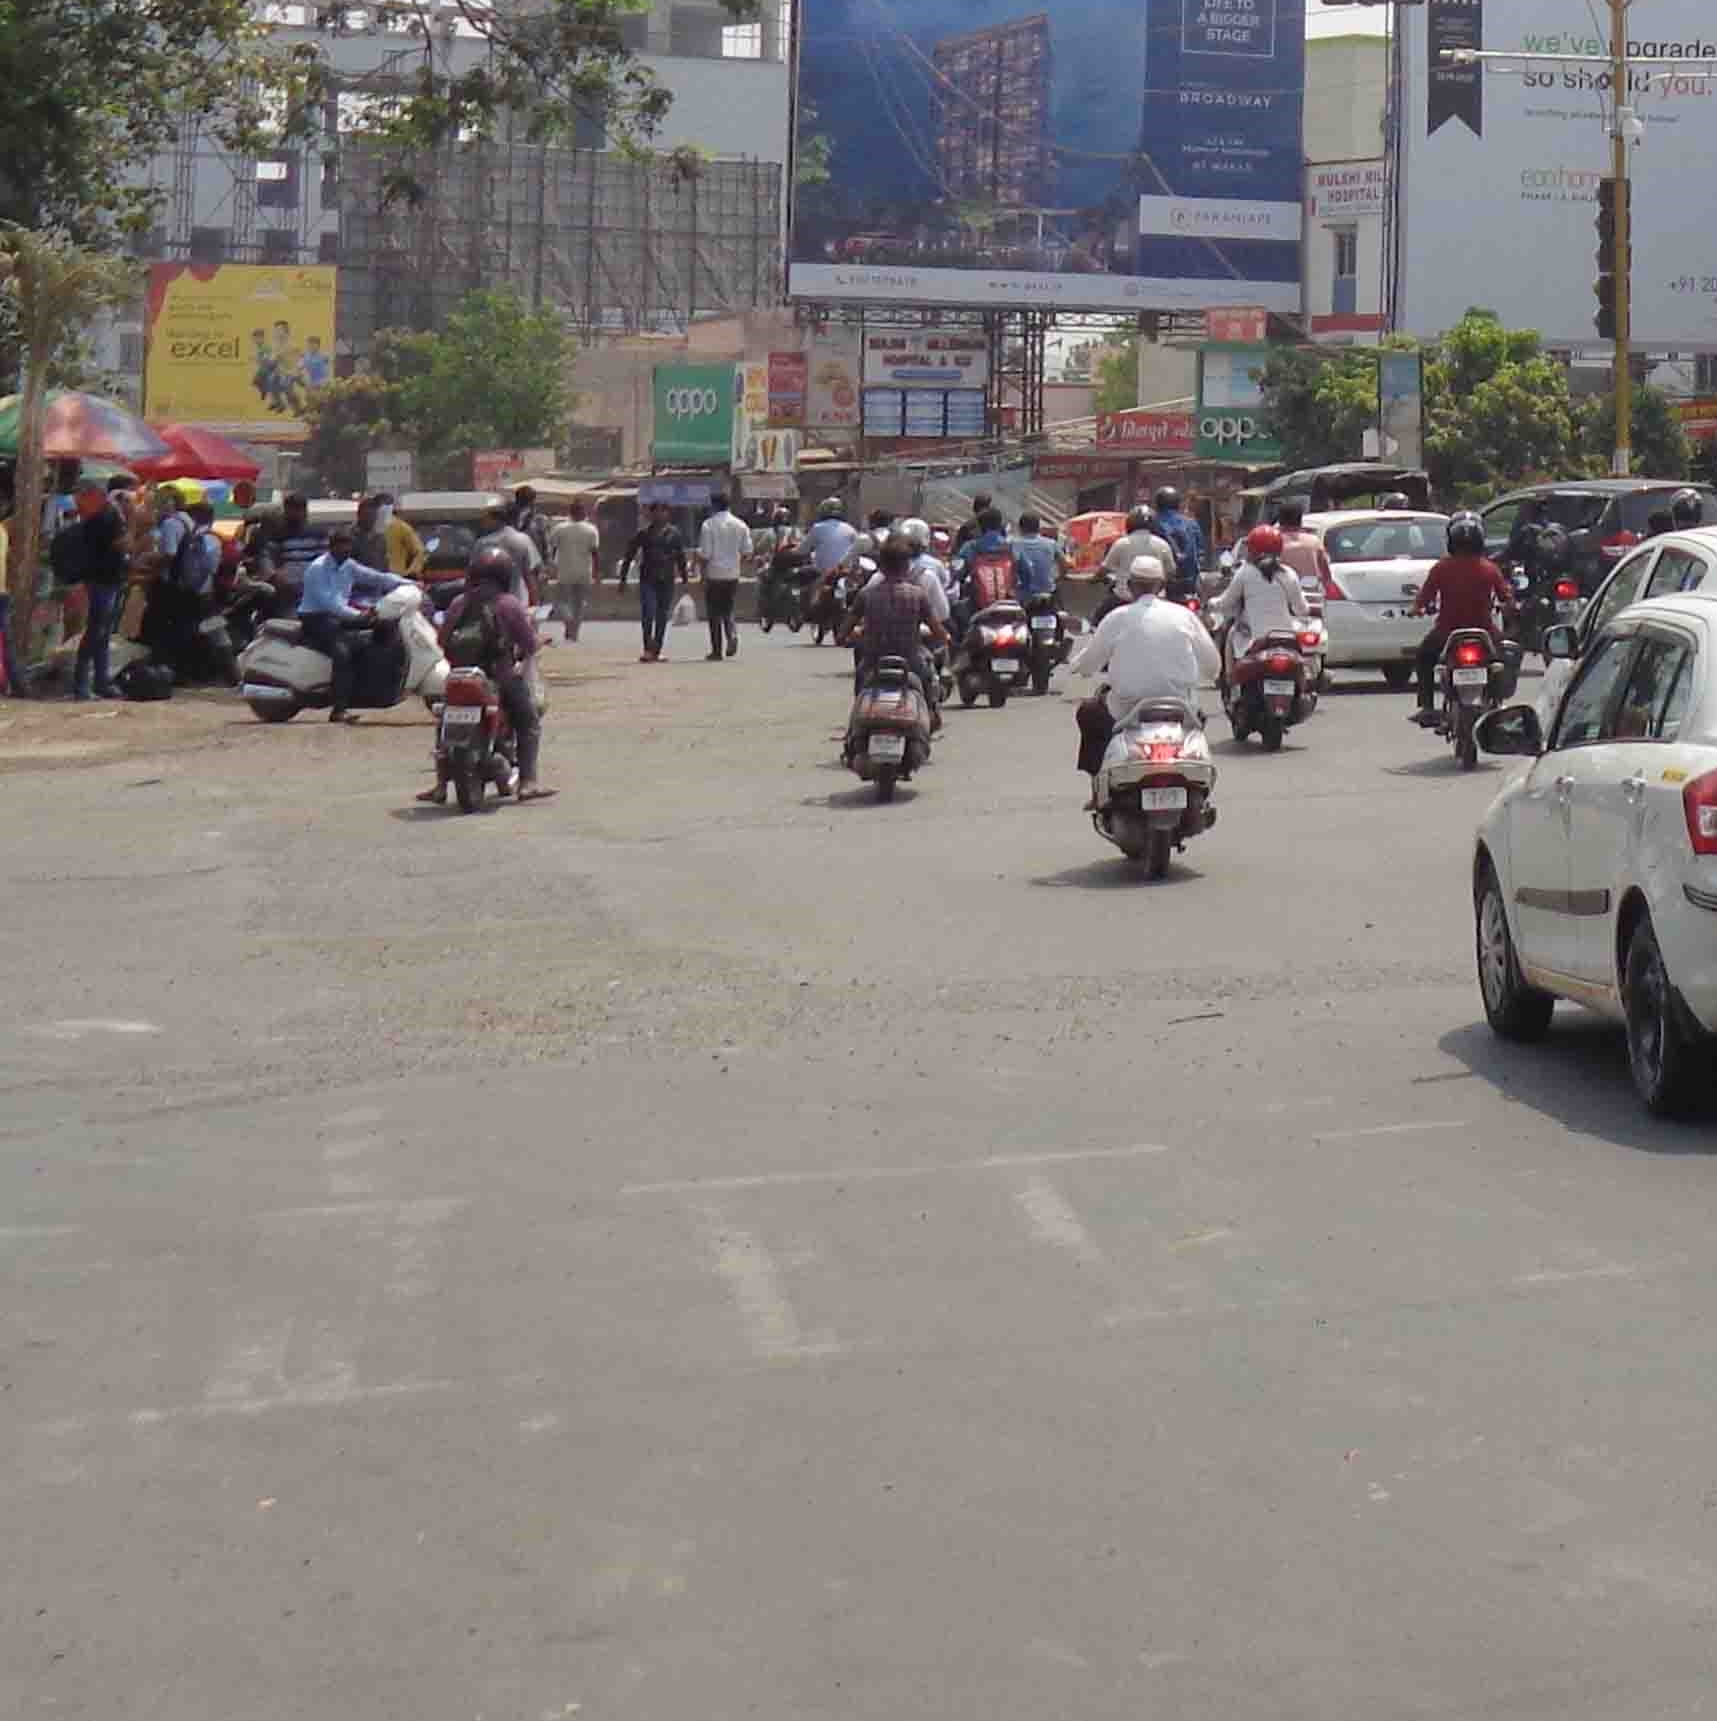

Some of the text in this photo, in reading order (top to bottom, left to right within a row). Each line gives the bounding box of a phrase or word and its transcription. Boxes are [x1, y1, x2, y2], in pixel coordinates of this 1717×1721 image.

[1563, 68, 1649, 93] shold
[1179, 92, 1272, 109] BROADWAY
[171, 336, 240, 360] excel
[666, 385, 717, 421] oppo
[1200, 416, 1273, 446] opp
